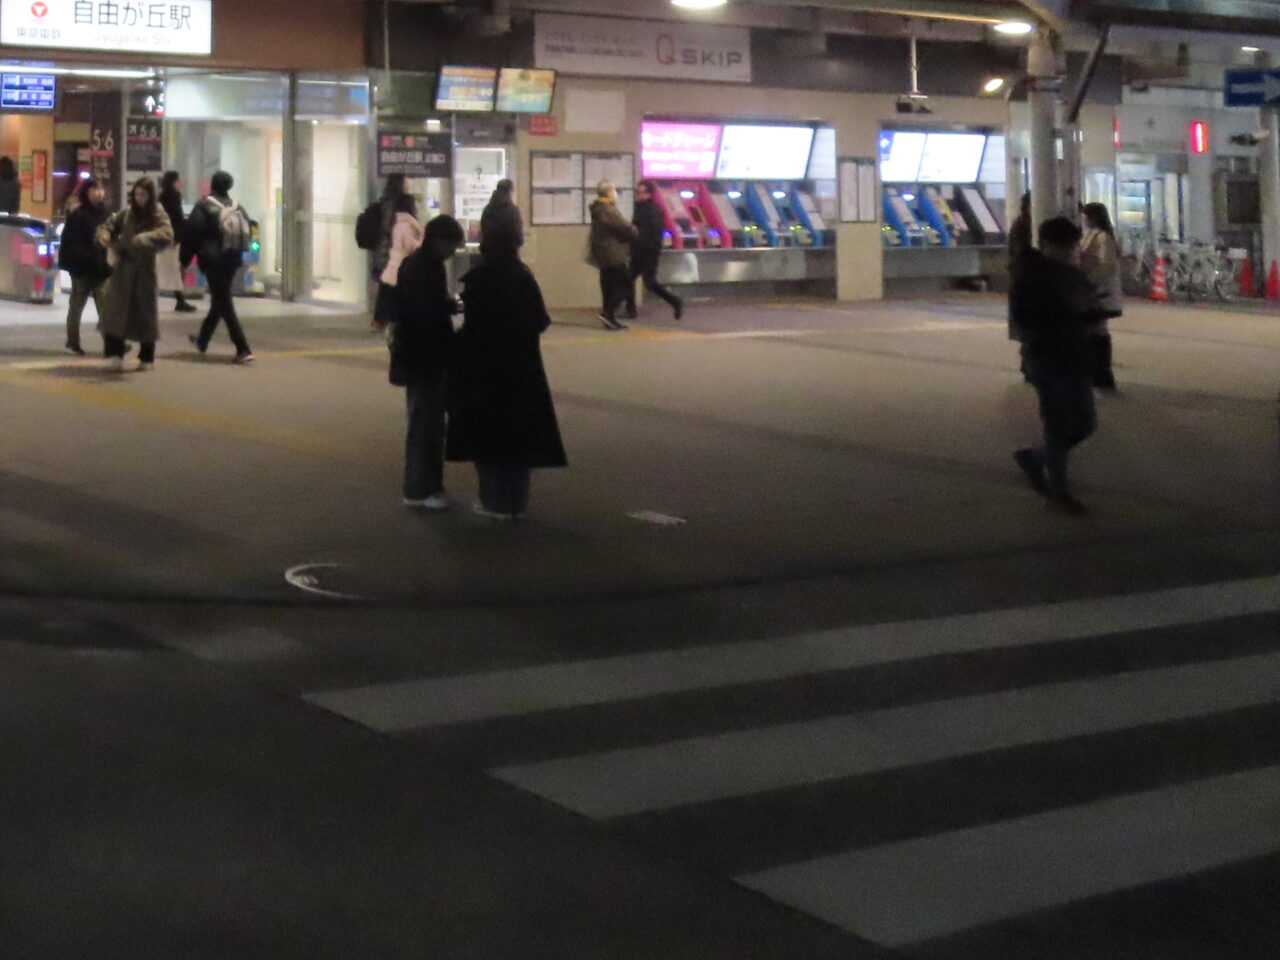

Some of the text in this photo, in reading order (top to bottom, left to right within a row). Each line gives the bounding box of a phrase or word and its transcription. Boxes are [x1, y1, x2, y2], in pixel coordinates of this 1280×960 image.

[17, 27, 61, 40] 東急電鉄
[94, 30, 148, 47] Jiyugaoka
[682, 48, 742, 67] SKIP
